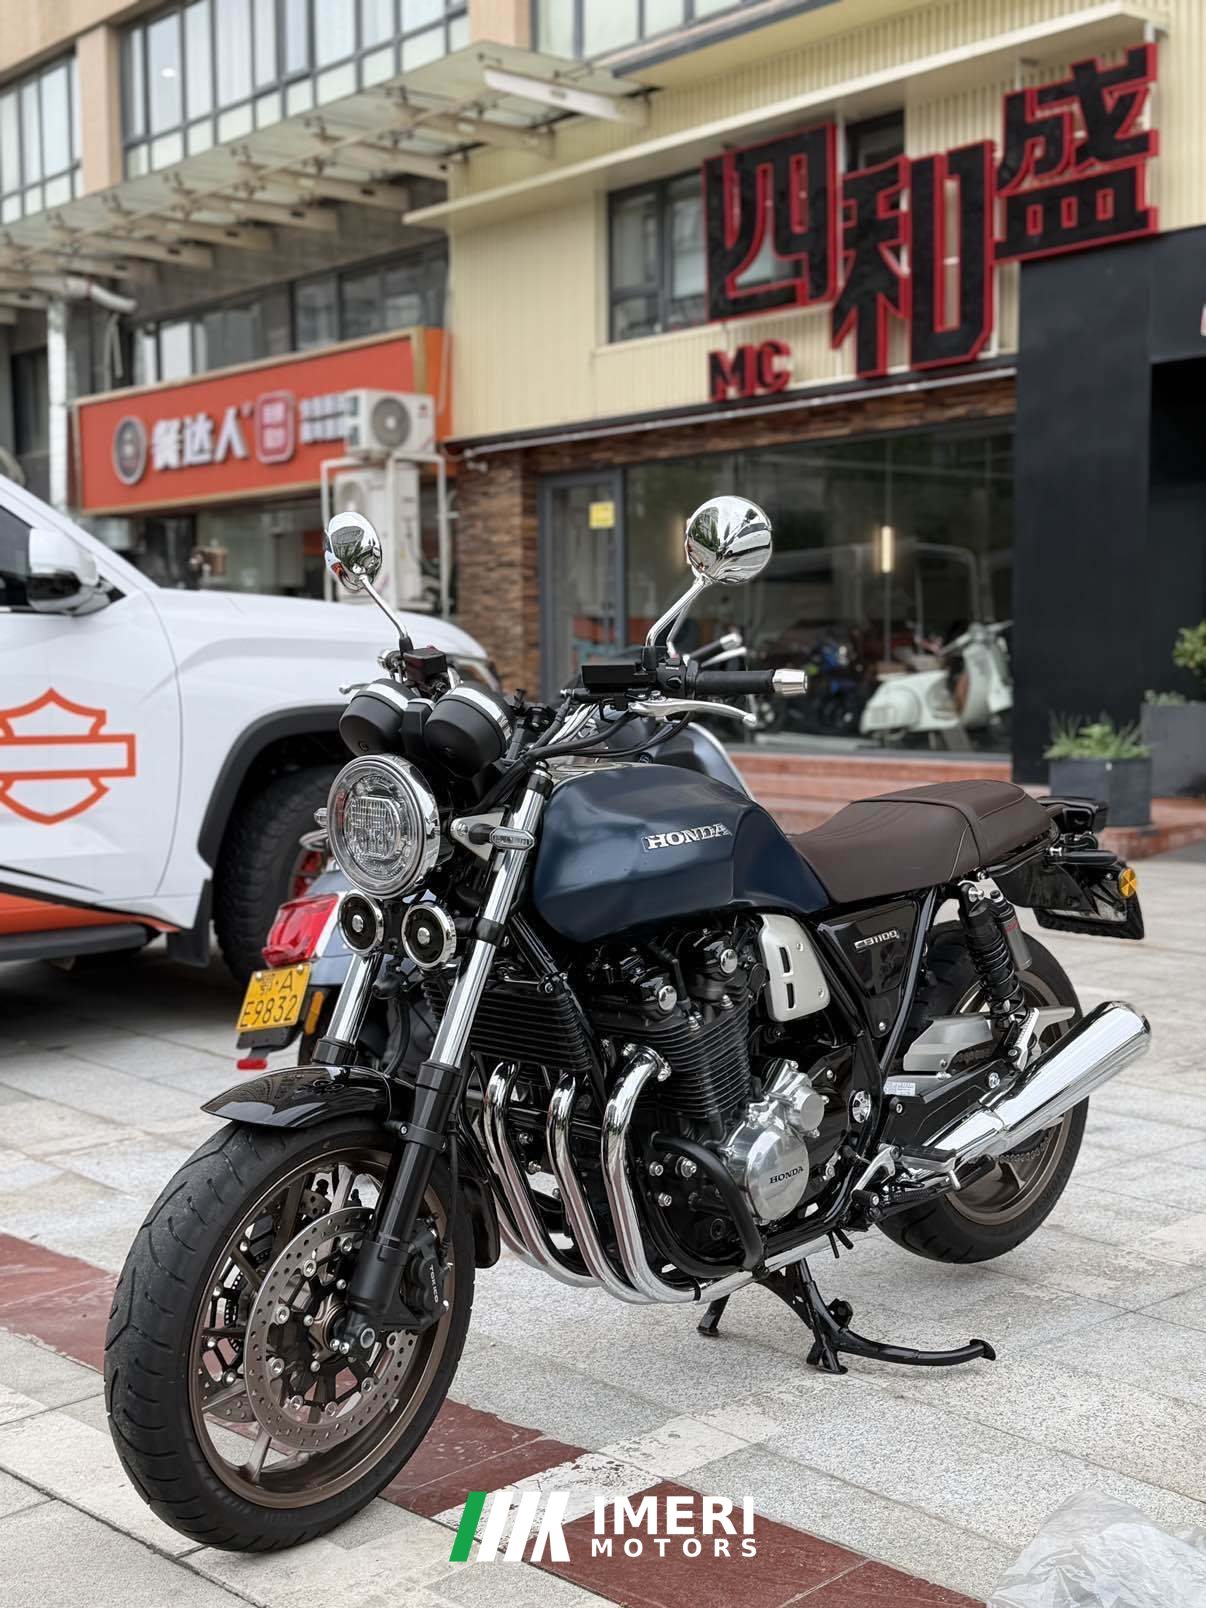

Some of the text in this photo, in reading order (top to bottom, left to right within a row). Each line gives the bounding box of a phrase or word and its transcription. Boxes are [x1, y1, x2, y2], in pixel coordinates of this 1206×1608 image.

[703, 42, 1158, 379] 四和盛
[707, 340, 791, 402] MC
[644, 823, 733, 850] HONDA
[239, 994, 298, 1028] E9832
[769, 1166, 804, 1184] HONDA
[429, 1263, 439, 1303] TOKICO
